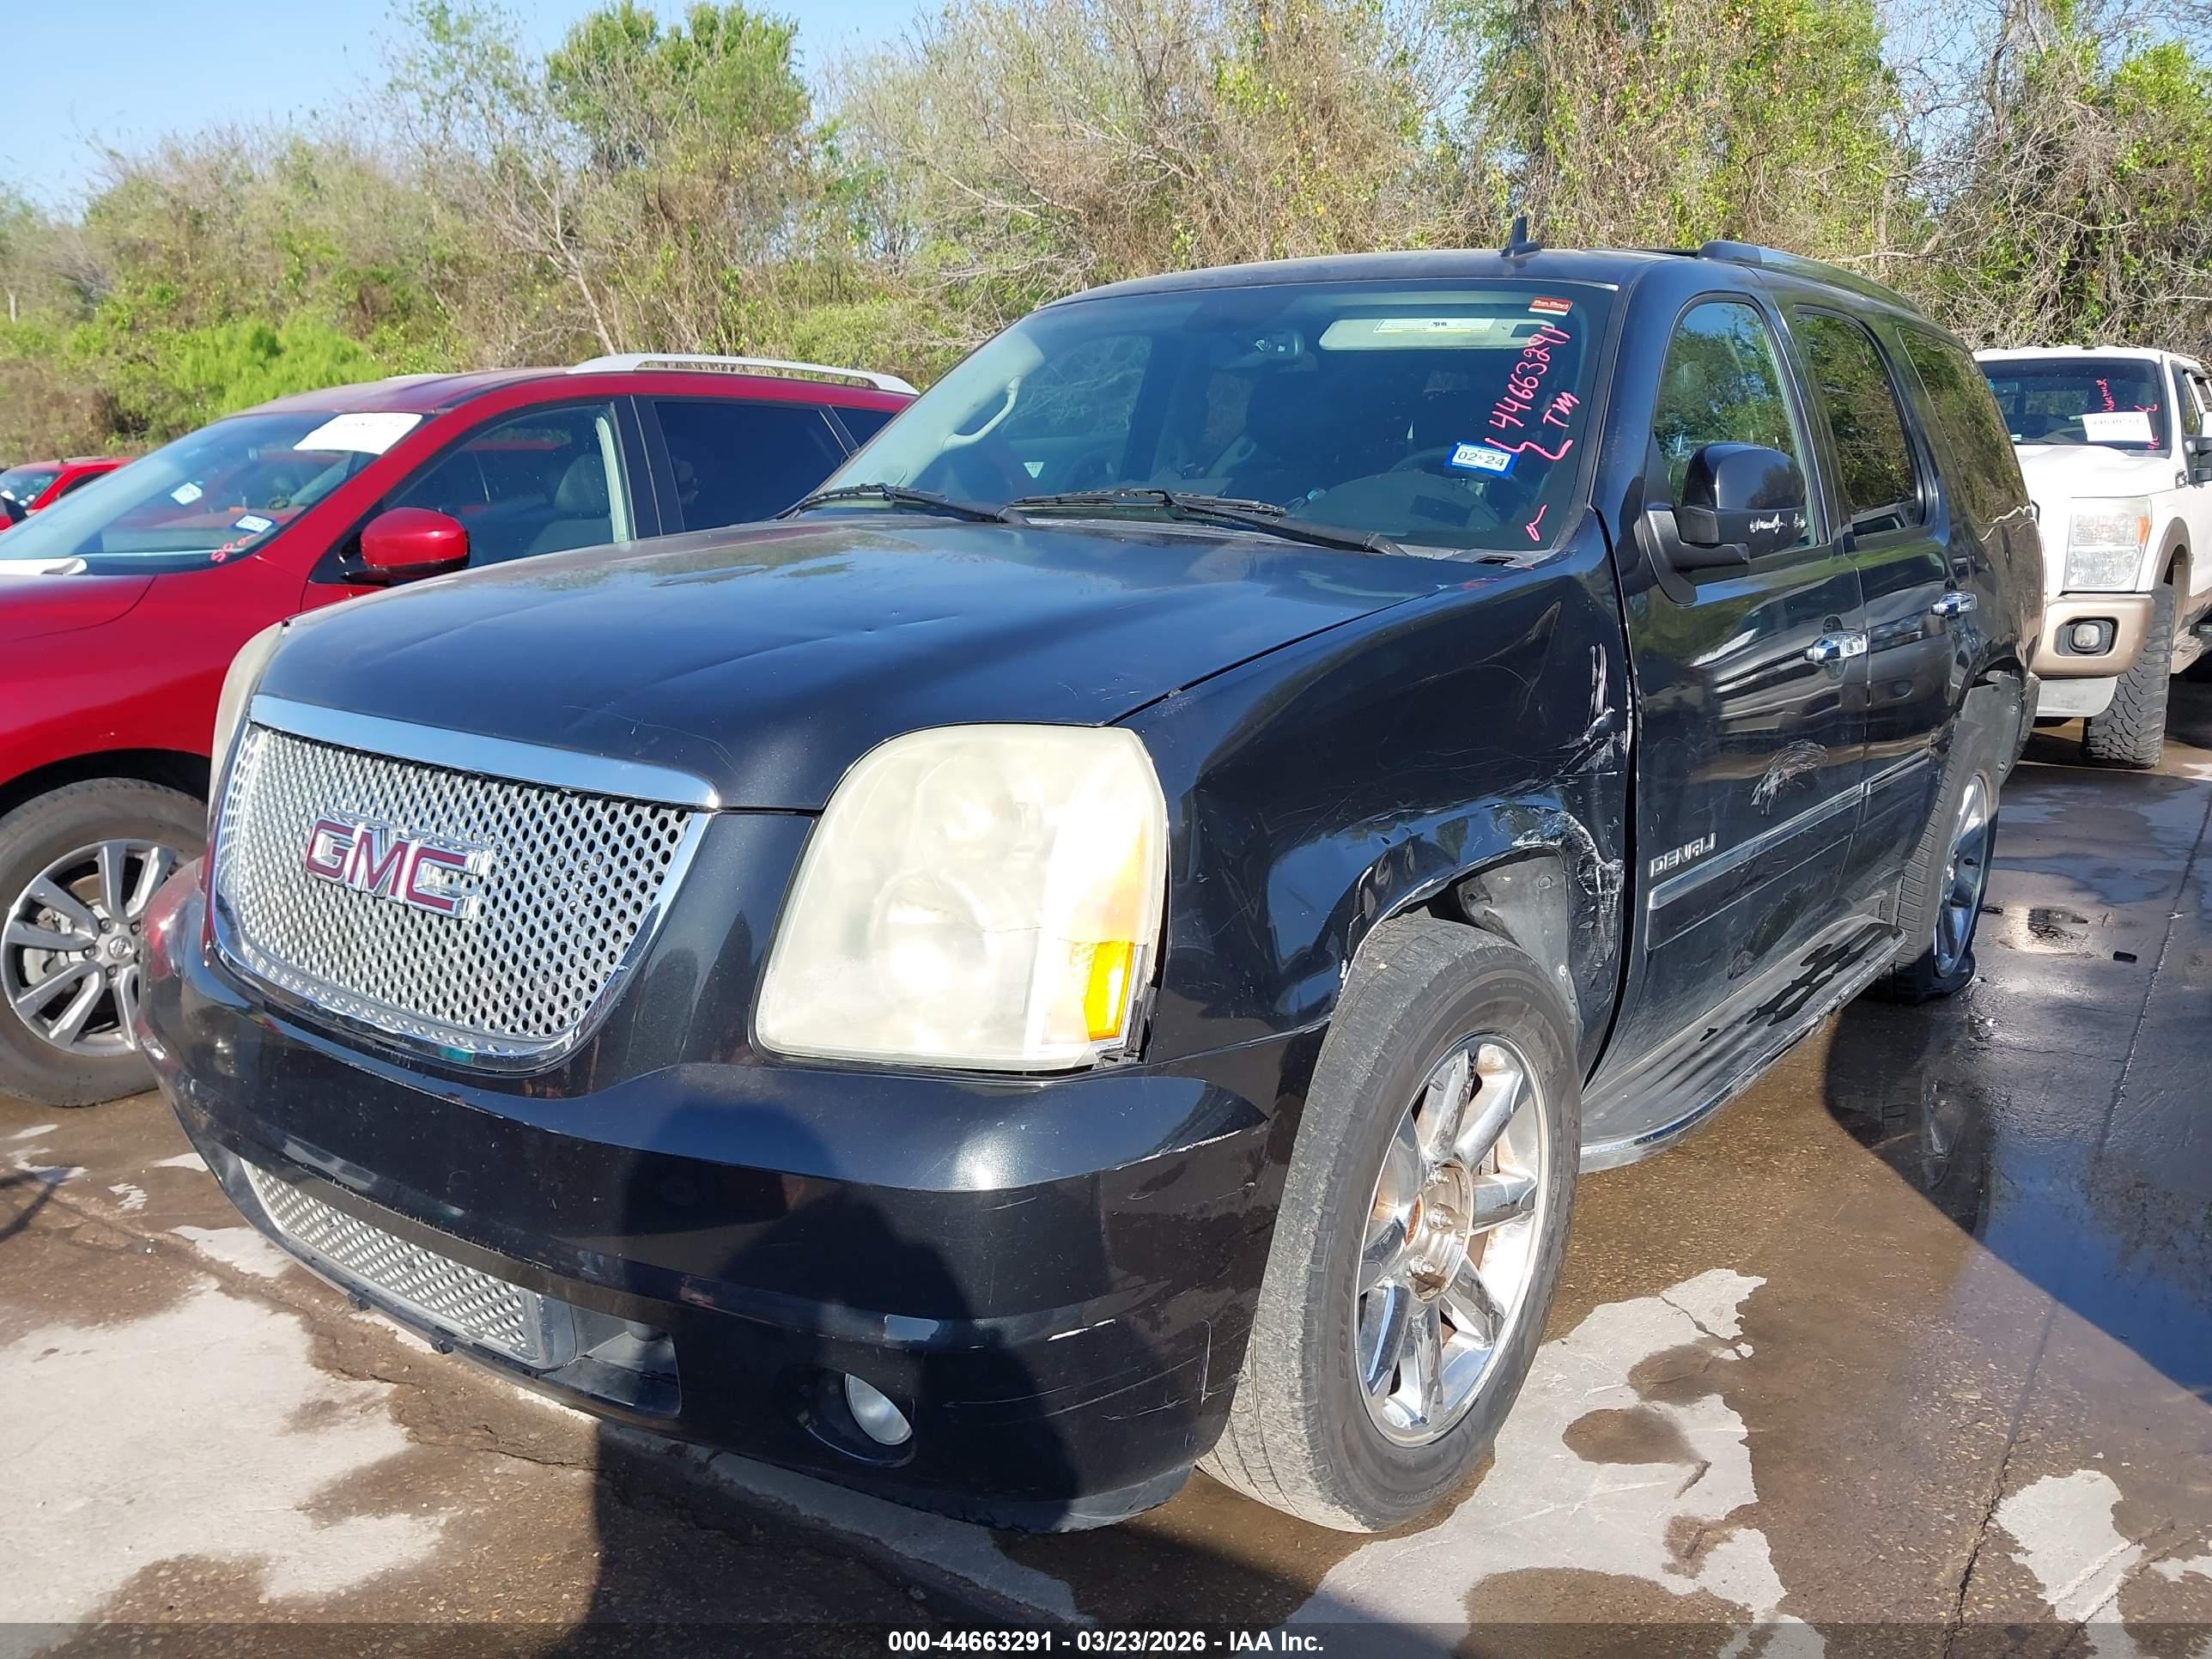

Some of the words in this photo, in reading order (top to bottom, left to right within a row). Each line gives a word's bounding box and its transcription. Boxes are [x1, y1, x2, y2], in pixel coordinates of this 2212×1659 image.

[1488, 325, 1571, 428] 44663291
[1457, 451, 1478, 462] 02
[1484, 455, 1505, 467] 24
[305, 817, 472, 916] GMC
[1648, 831, 1717, 878] DENALI
